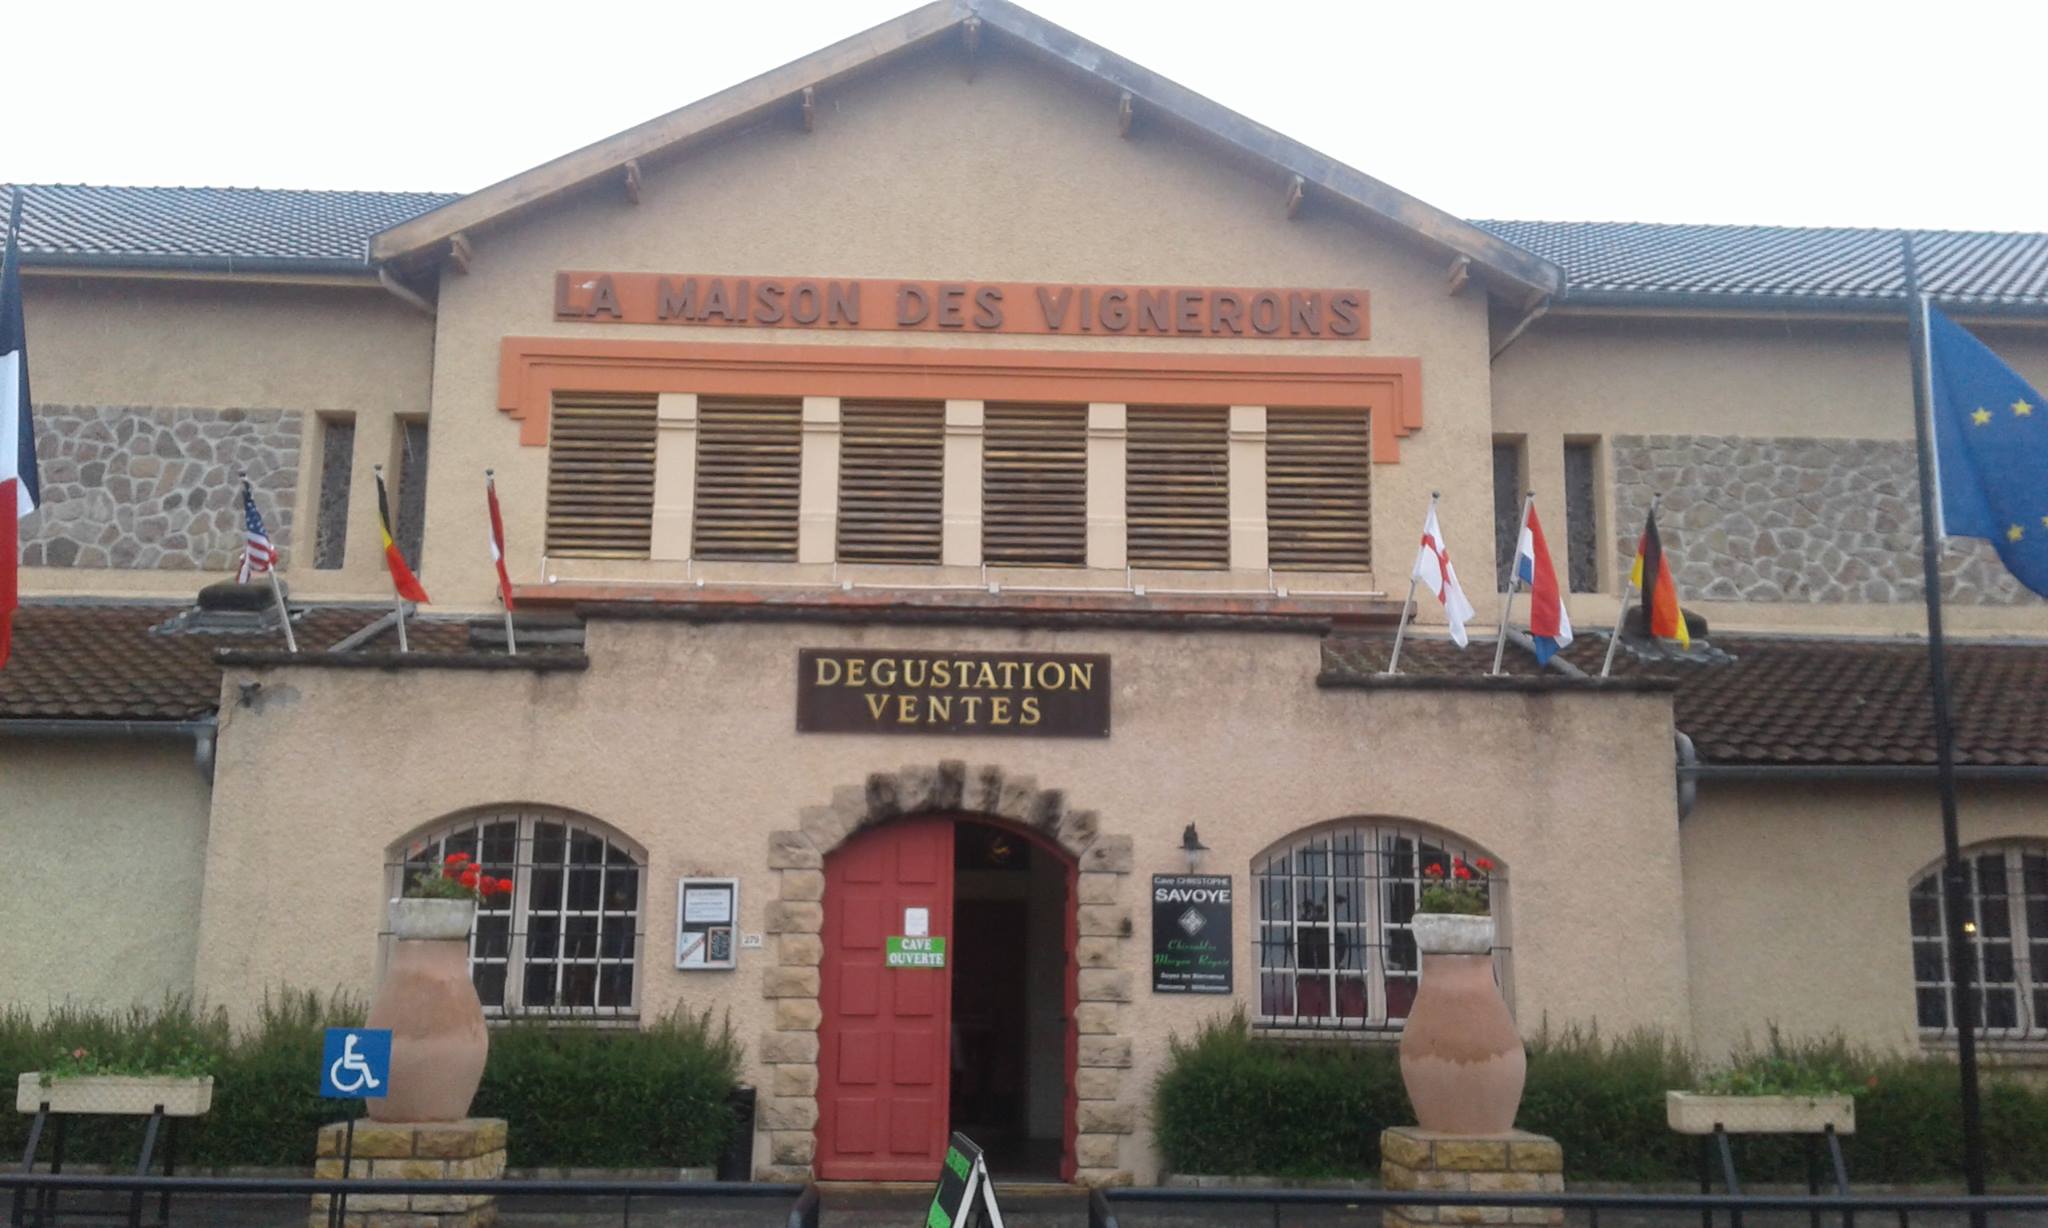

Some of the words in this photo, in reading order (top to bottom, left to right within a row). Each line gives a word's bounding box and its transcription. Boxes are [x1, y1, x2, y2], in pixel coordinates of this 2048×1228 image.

[556, 272, 622, 319] LA
[656, 276, 860, 327] MAISON
[897, 283, 1004, 330] DES
[1036, 286, 1361, 337] VIGNERONS
[815, 658, 1094, 691] DEGUSTATION
[865, 693, 1042, 725] VENTES
[1155, 888, 1232, 902] SAVOYE
[902, 938, 932, 950] CAVE
[889, 952, 944, 965] OUVERTE
